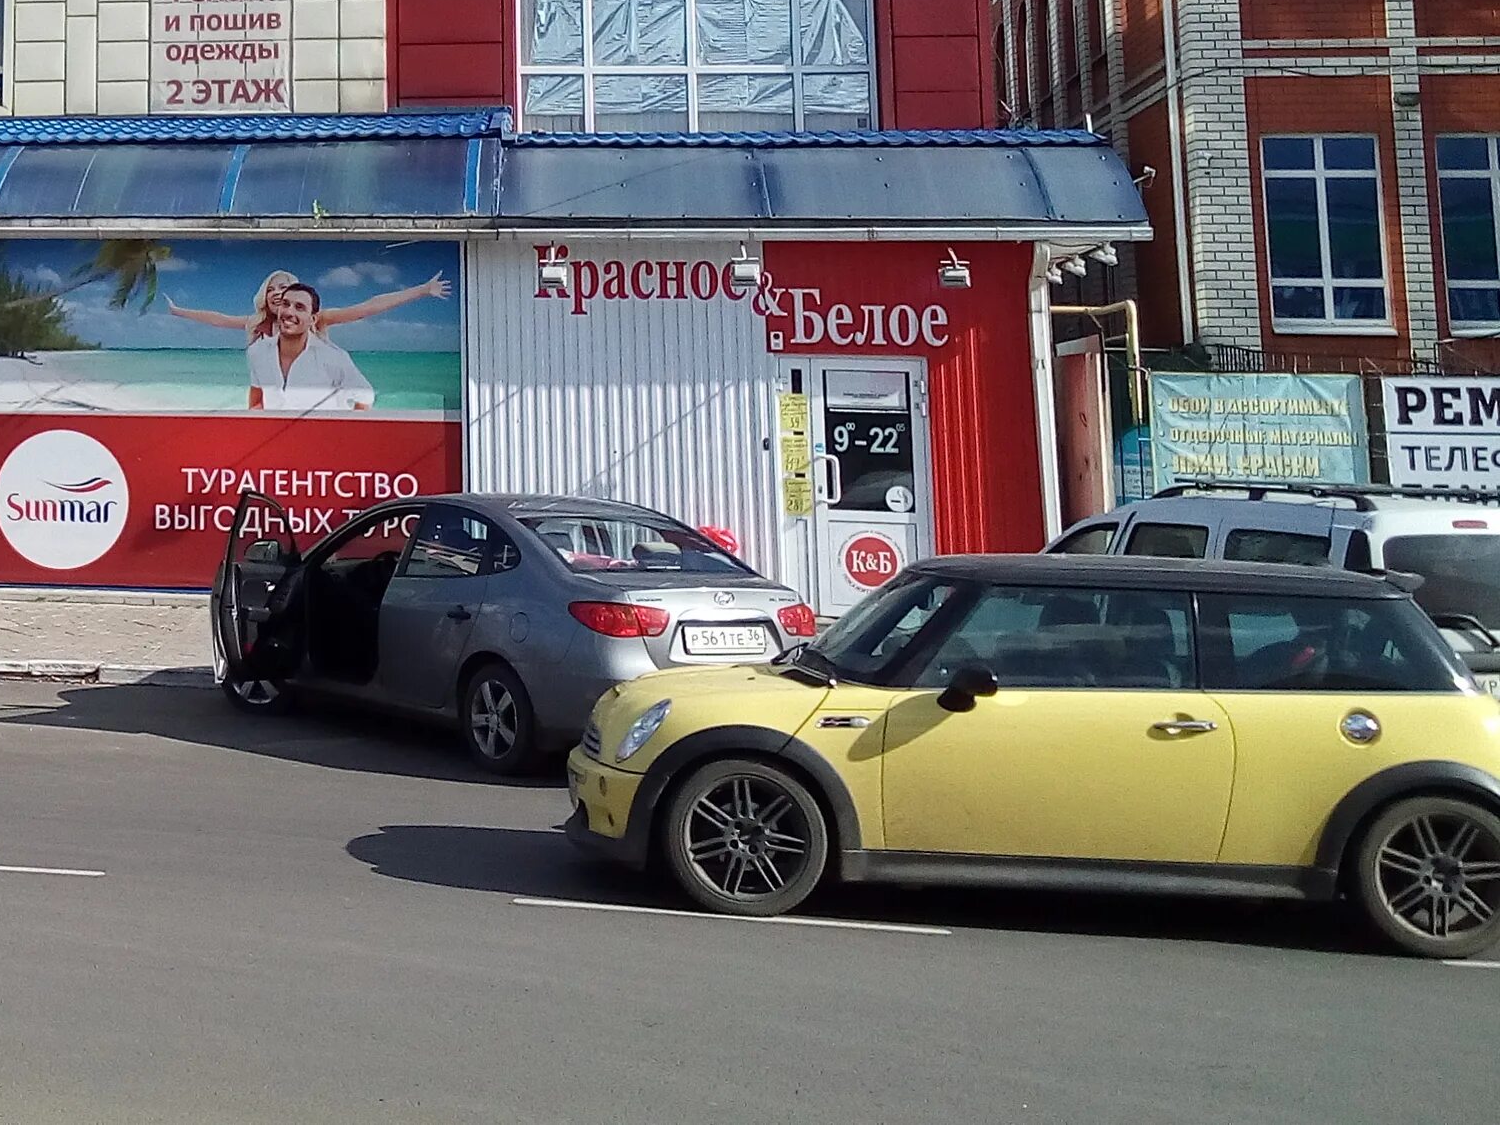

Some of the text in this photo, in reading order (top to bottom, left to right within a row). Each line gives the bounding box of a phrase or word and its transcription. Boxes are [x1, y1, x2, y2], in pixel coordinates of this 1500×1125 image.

[164, 12, 282, 32] и пошив
[165, 42, 280, 65] одежды
[166, 78, 286, 105] 2 ЭТАЖ
[752, 271, 789, 317] &
[788, 287, 950, 347] Белое
[181, 467, 419, 499] ТУРАГЕНТСТВО
[6, 492, 118, 524] Sunmar
